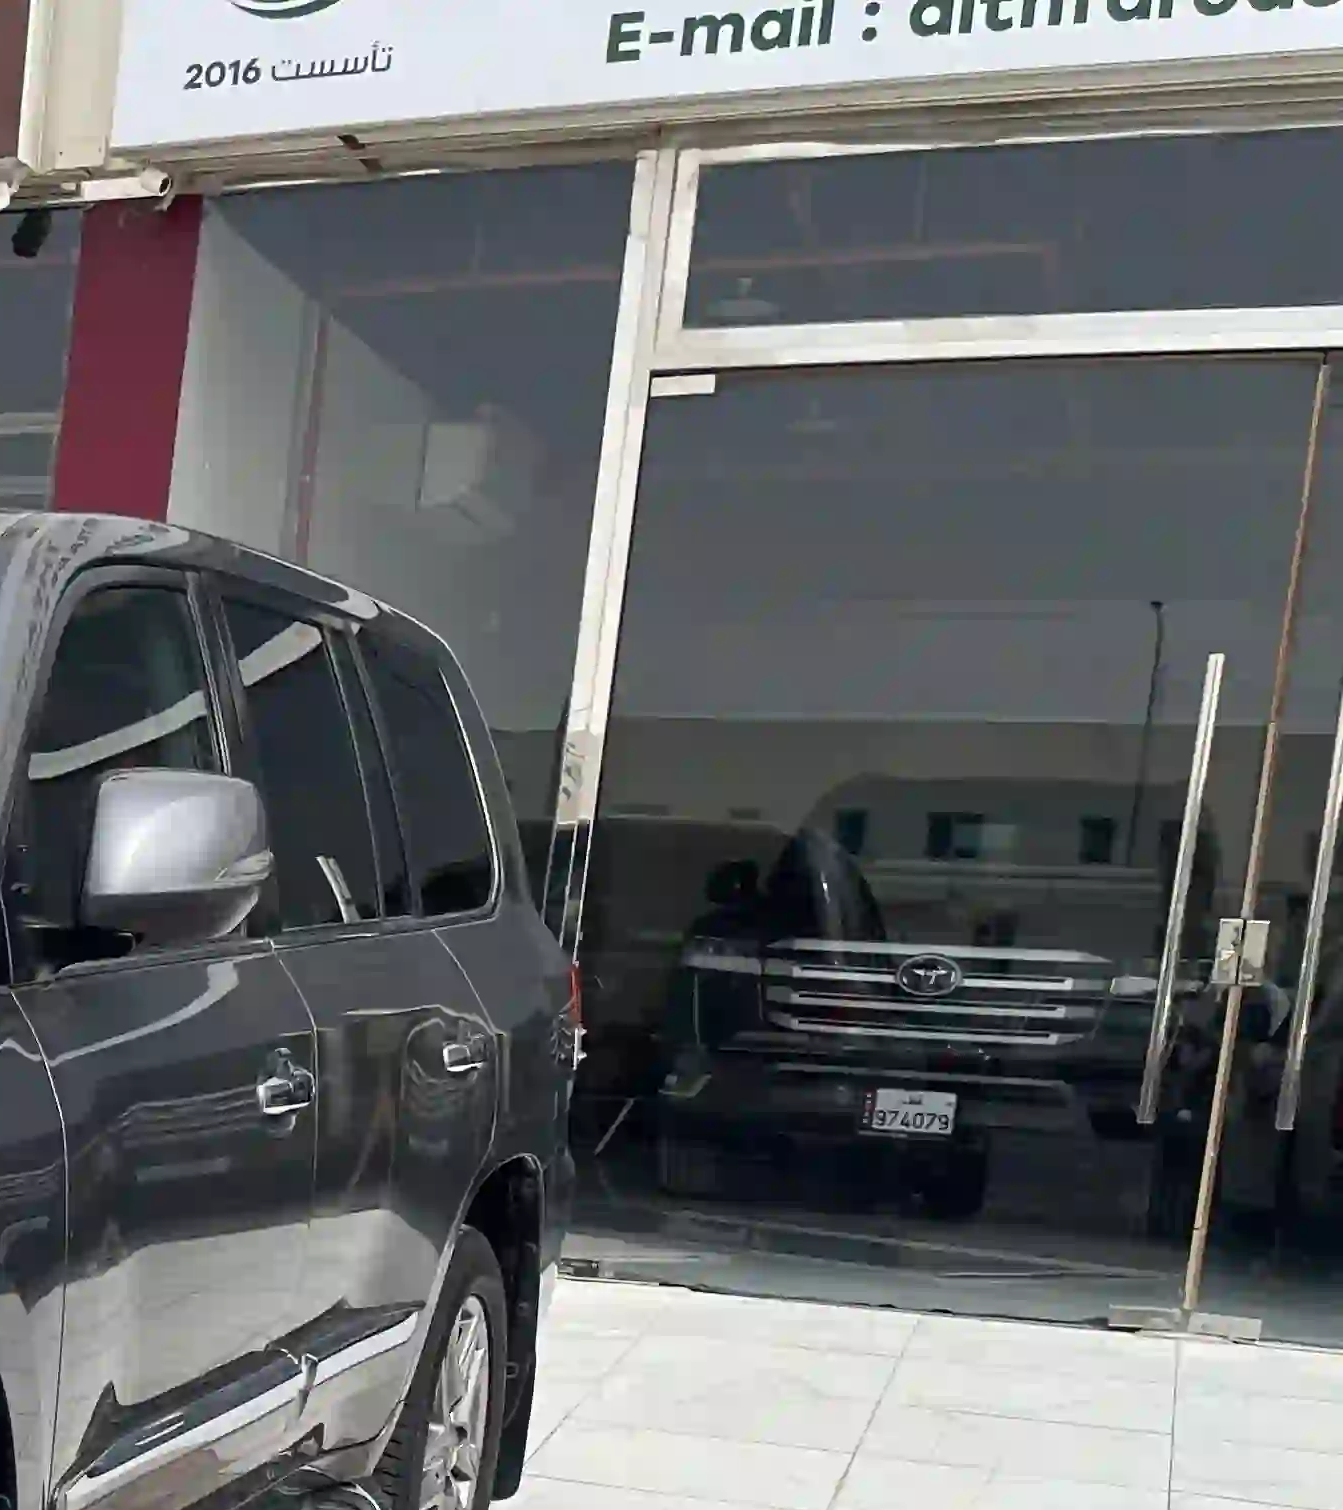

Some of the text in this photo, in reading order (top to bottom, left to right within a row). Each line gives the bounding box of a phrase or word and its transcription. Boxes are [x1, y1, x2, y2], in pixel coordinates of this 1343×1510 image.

[606, 0, 835, 63] E-mail
[183, 40, 394, 89] تأسست 2016
[875, 1109, 950, 1130] 974079
